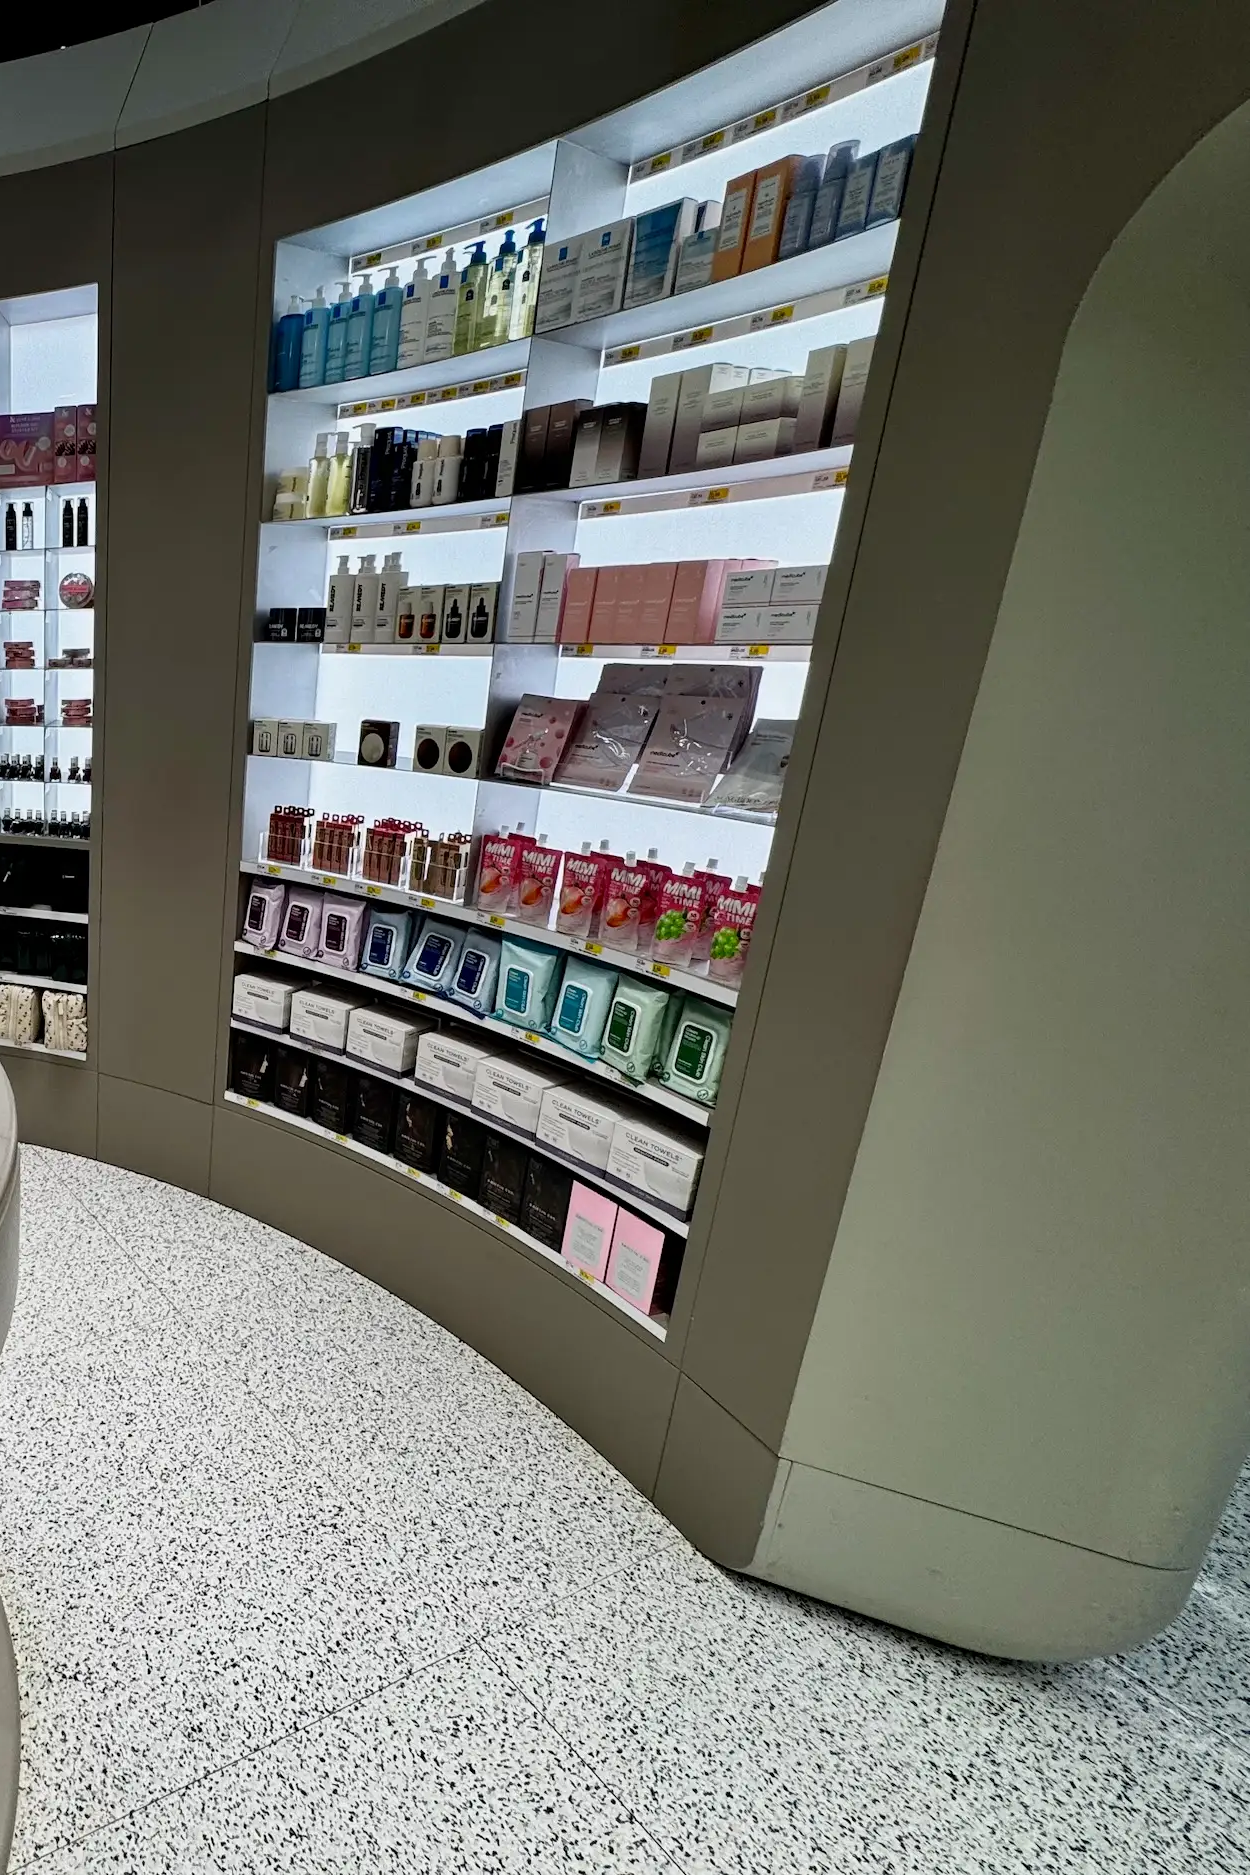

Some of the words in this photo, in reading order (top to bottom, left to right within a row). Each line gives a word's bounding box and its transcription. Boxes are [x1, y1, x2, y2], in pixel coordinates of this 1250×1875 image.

[486, 842, 515, 856] MIMI
[522, 850, 556, 868] MIMI
[567, 858, 598, 876] MIMI
[531, 864, 552, 874] TIME
[611, 868, 646, 888] MIMI
[622, 884, 642, 895] TIME
[664, 880, 702, 900] MIMI
[673, 896, 700, 909] TIME
[716, 895, 756, 918] MIMI
[726, 912, 752, 926] TIME
[299, 1000, 316, 1010] CLEAN
[356, 1018, 373, 1028] CLEAN
[427, 1042, 445, 1054] CLEAN
[446, 1049, 467, 1062] TOWELS
[486, 1068, 504, 1080] CLEAN
[506, 1076, 529, 1091] TOWELS
[552, 1100, 573, 1112] CLEAN
[574, 1108, 600, 1125] TOWELS
[626, 1132, 649, 1147] CLEAN
[650, 1143, 680, 1162] TOWELS
